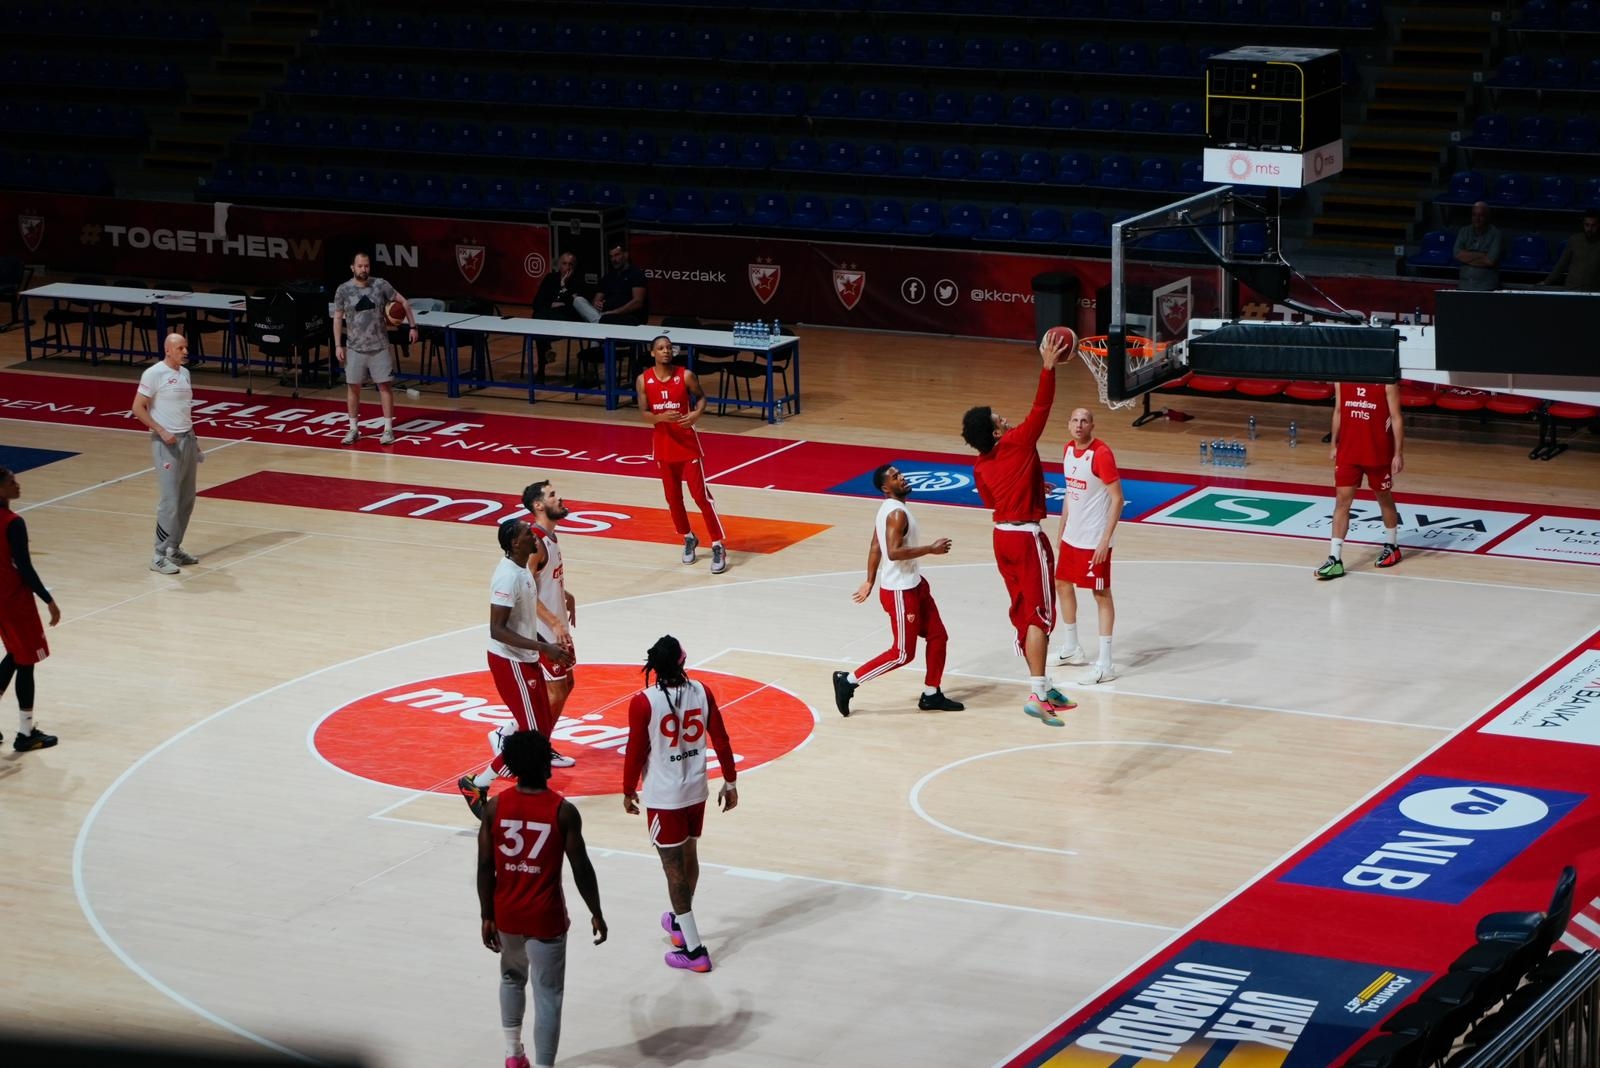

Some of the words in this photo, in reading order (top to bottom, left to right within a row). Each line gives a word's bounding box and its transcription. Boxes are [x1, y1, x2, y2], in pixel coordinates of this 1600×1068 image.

[1255, 164, 1280, 175] mts
[644, 268, 727, 284] azvezdakk
[660, 390, 669, 400] 11
[1356, 387, 1367, 397] 12
[0, 398, 96, 415] ENA
[653, 400, 681, 411] meridian
[1344, 400, 1377, 410] meridian
[190, 399, 485, 436] ELGRADE
[1350, 410, 1371, 420] mts
[1072, 466, 1078, 475] 7
[660, 708, 705, 748] 95
[498, 819, 552, 859] 37
[1342, 830, 1475, 890] NLB
[1174, 962, 1251, 982] U
[1355, 975, 1412, 1013] ADMIRAL
[1075, 974, 1239, 1062] NAPADU
[1204, 991, 1319, 1052] UVEK
